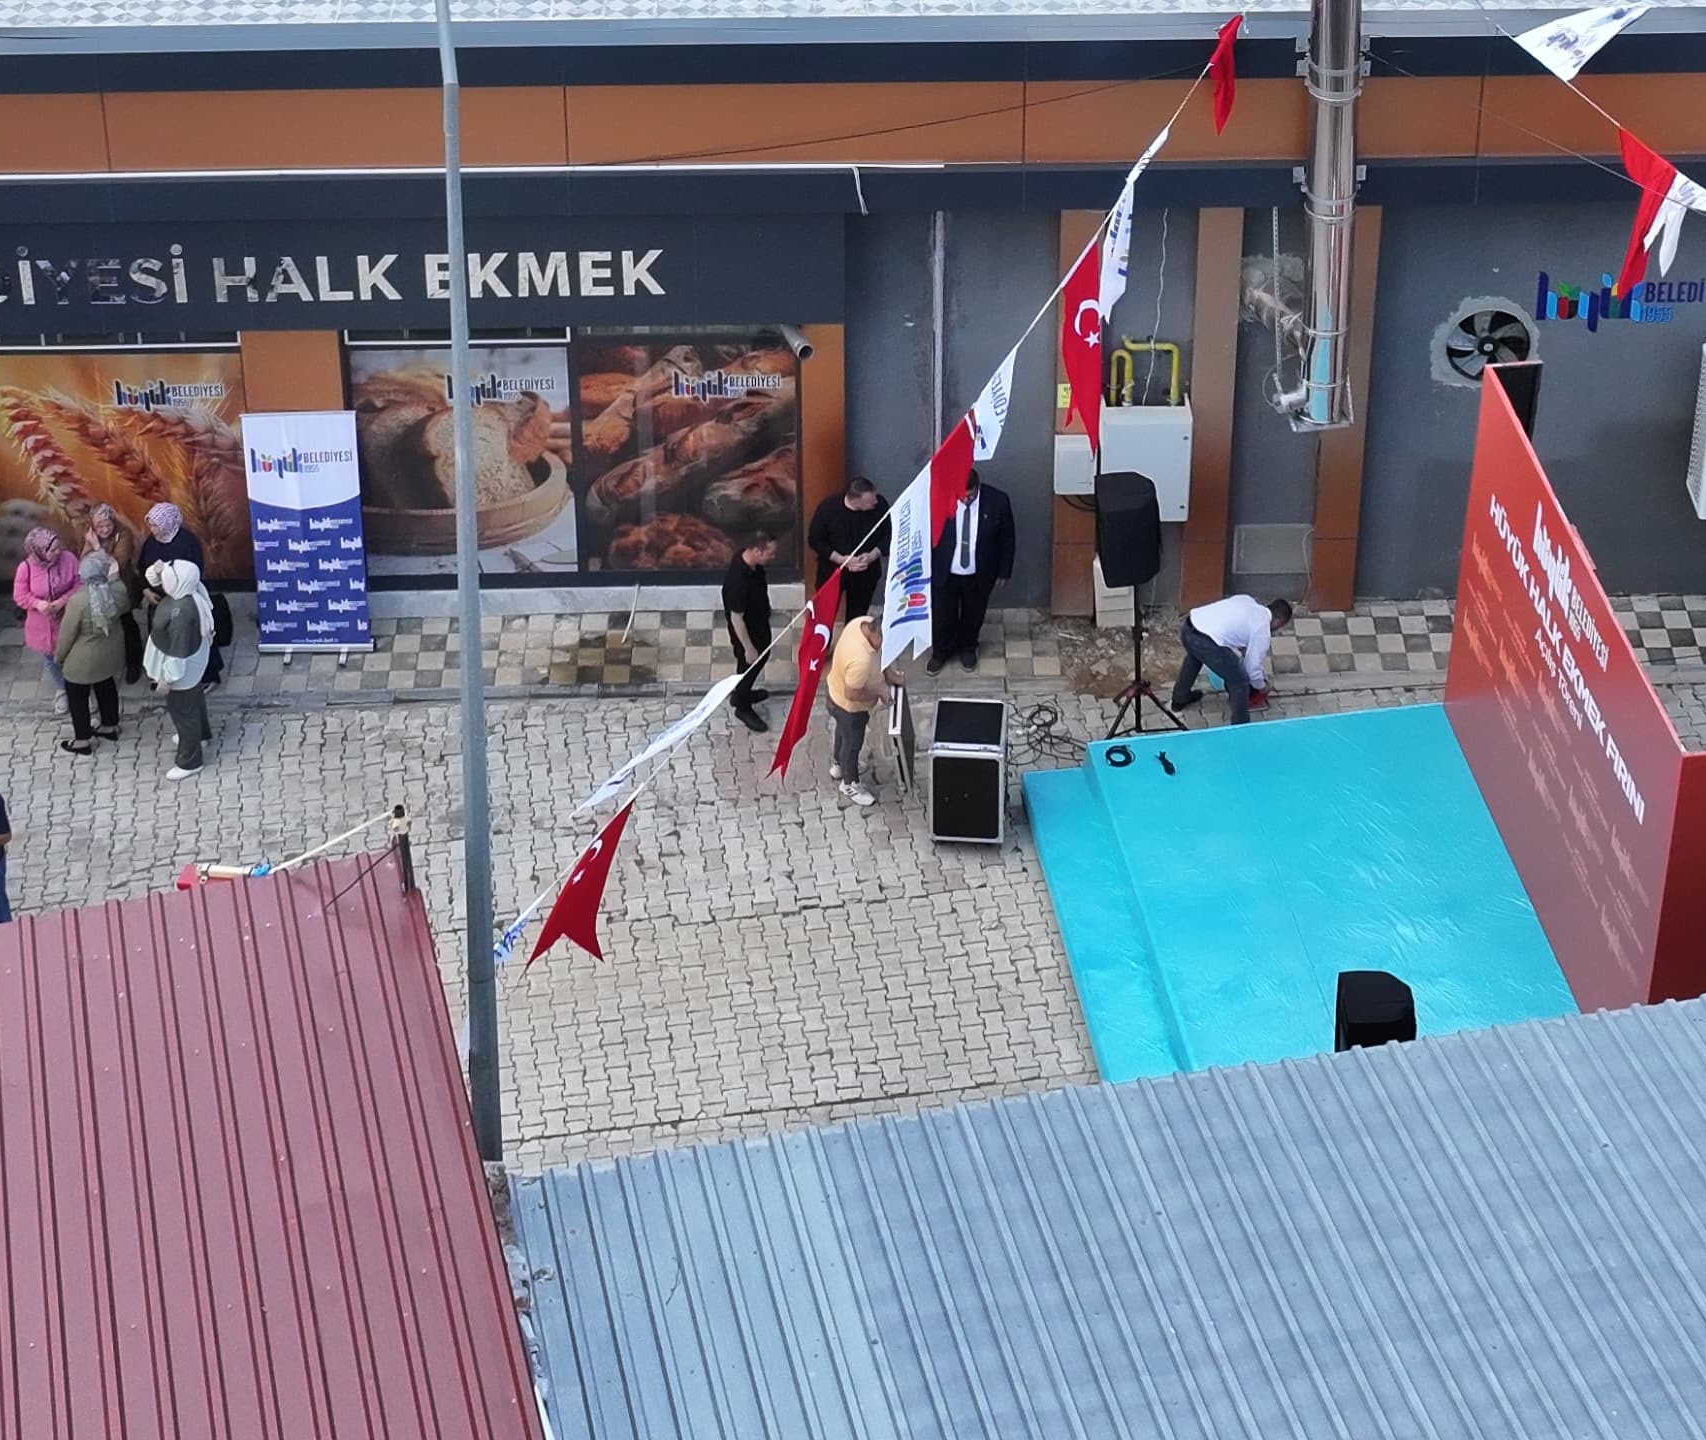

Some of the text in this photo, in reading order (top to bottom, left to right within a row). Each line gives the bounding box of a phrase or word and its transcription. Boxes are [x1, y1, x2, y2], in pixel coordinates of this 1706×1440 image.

[212, 254, 403, 303] HALK
[425, 249, 666, 299] EKMEK
[1643, 305, 1674, 323] 1955
[304, 448, 353, 463] BELEDİYESİ
[1489, 492, 1645, 826] HÜYÜK HALK EKMEK FIRINI
[1570, 582, 1610, 673] BELEDİYESİ
[1534, 627, 1583, 731] Açılış Töreni
